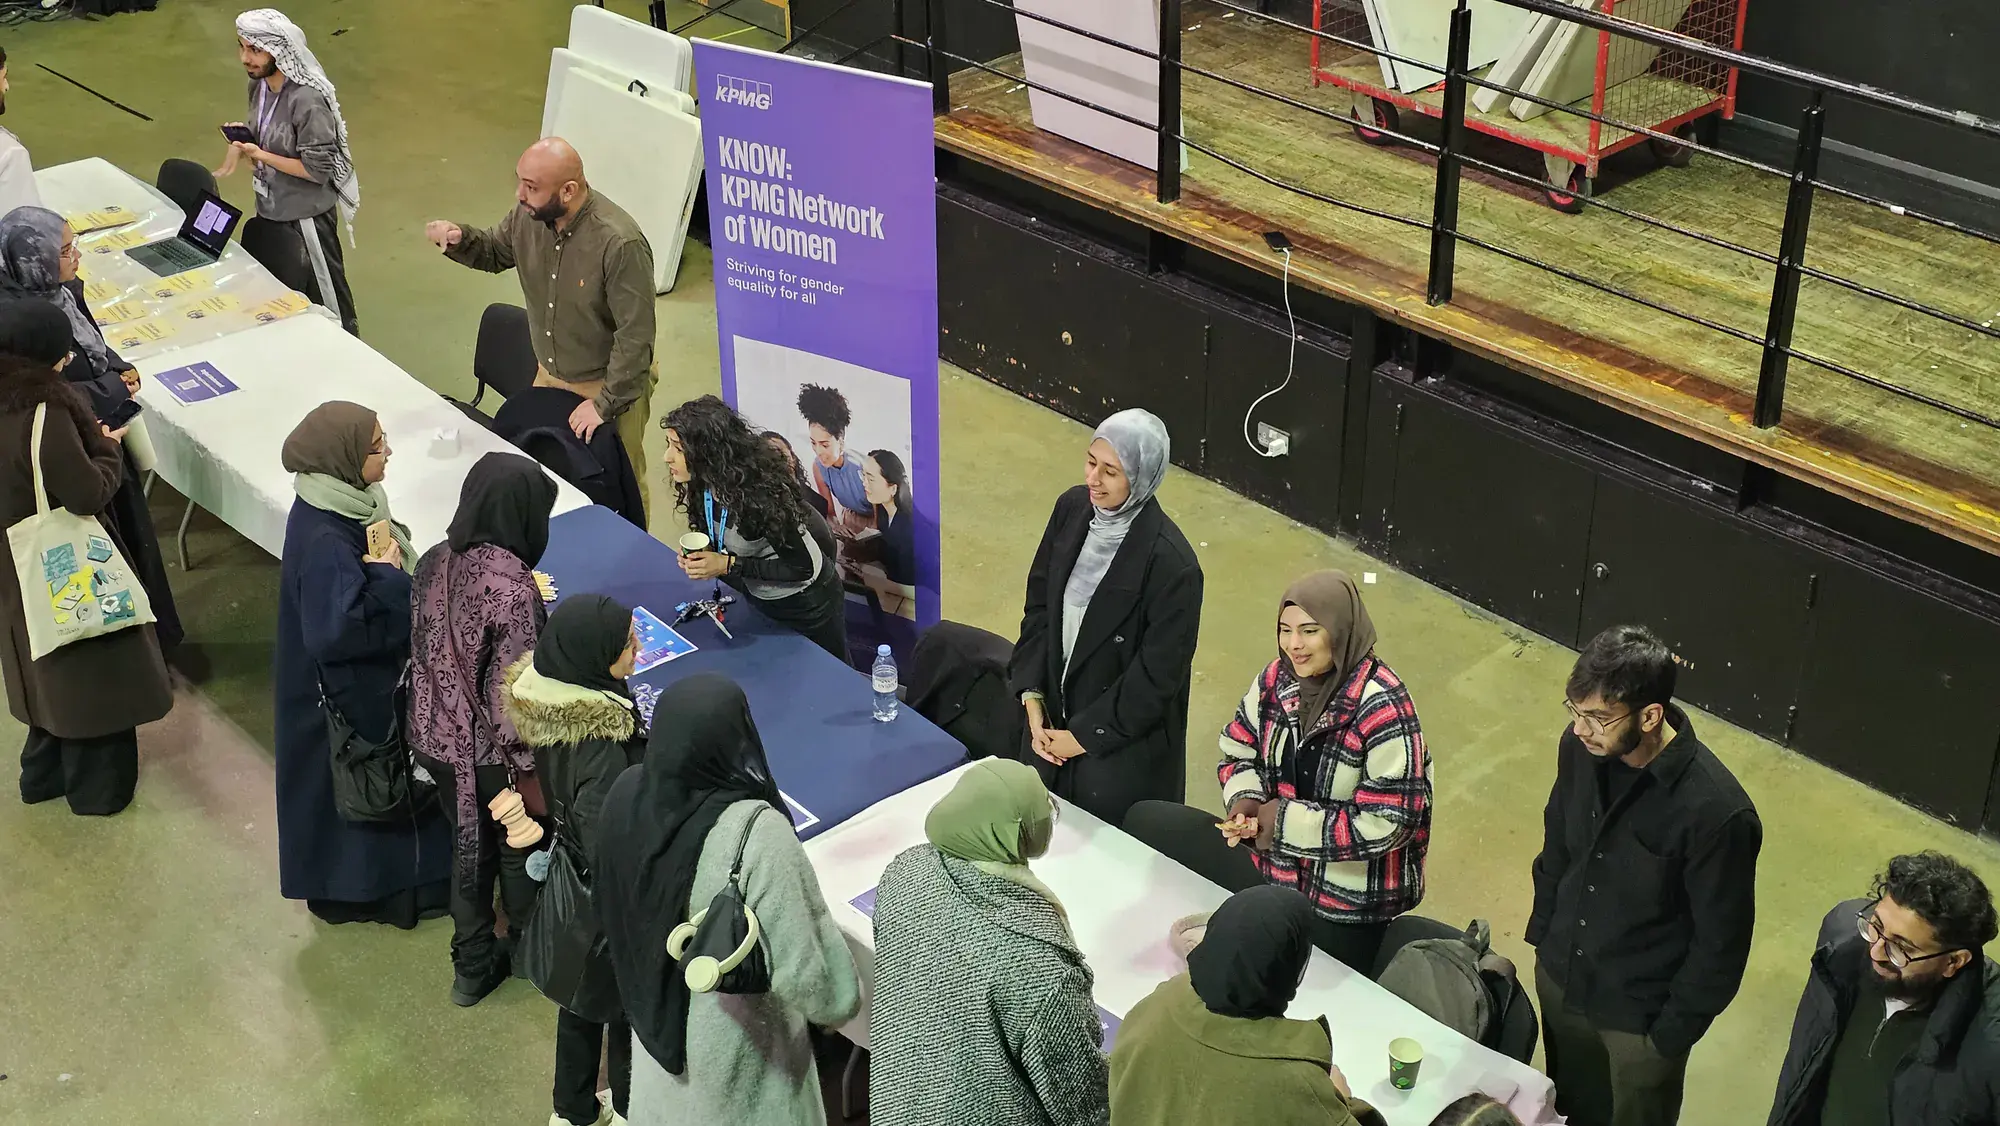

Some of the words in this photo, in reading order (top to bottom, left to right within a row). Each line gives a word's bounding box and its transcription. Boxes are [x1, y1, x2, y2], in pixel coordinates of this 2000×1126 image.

[715, 85, 772, 110] KPMG
[718, 135, 793, 181] KNOW:
[721, 173, 785, 216] KPMG
[788, 187, 885, 240] Network
[724, 215, 746, 244] of
[749, 217, 837, 264] Women
[726, 258, 775, 281] Striving
[779, 269, 797, 284] for
[800, 276, 844, 295] gender
[727, 276, 776, 298] equality
[780, 286, 798, 301] for
[801, 291, 816, 305] all
